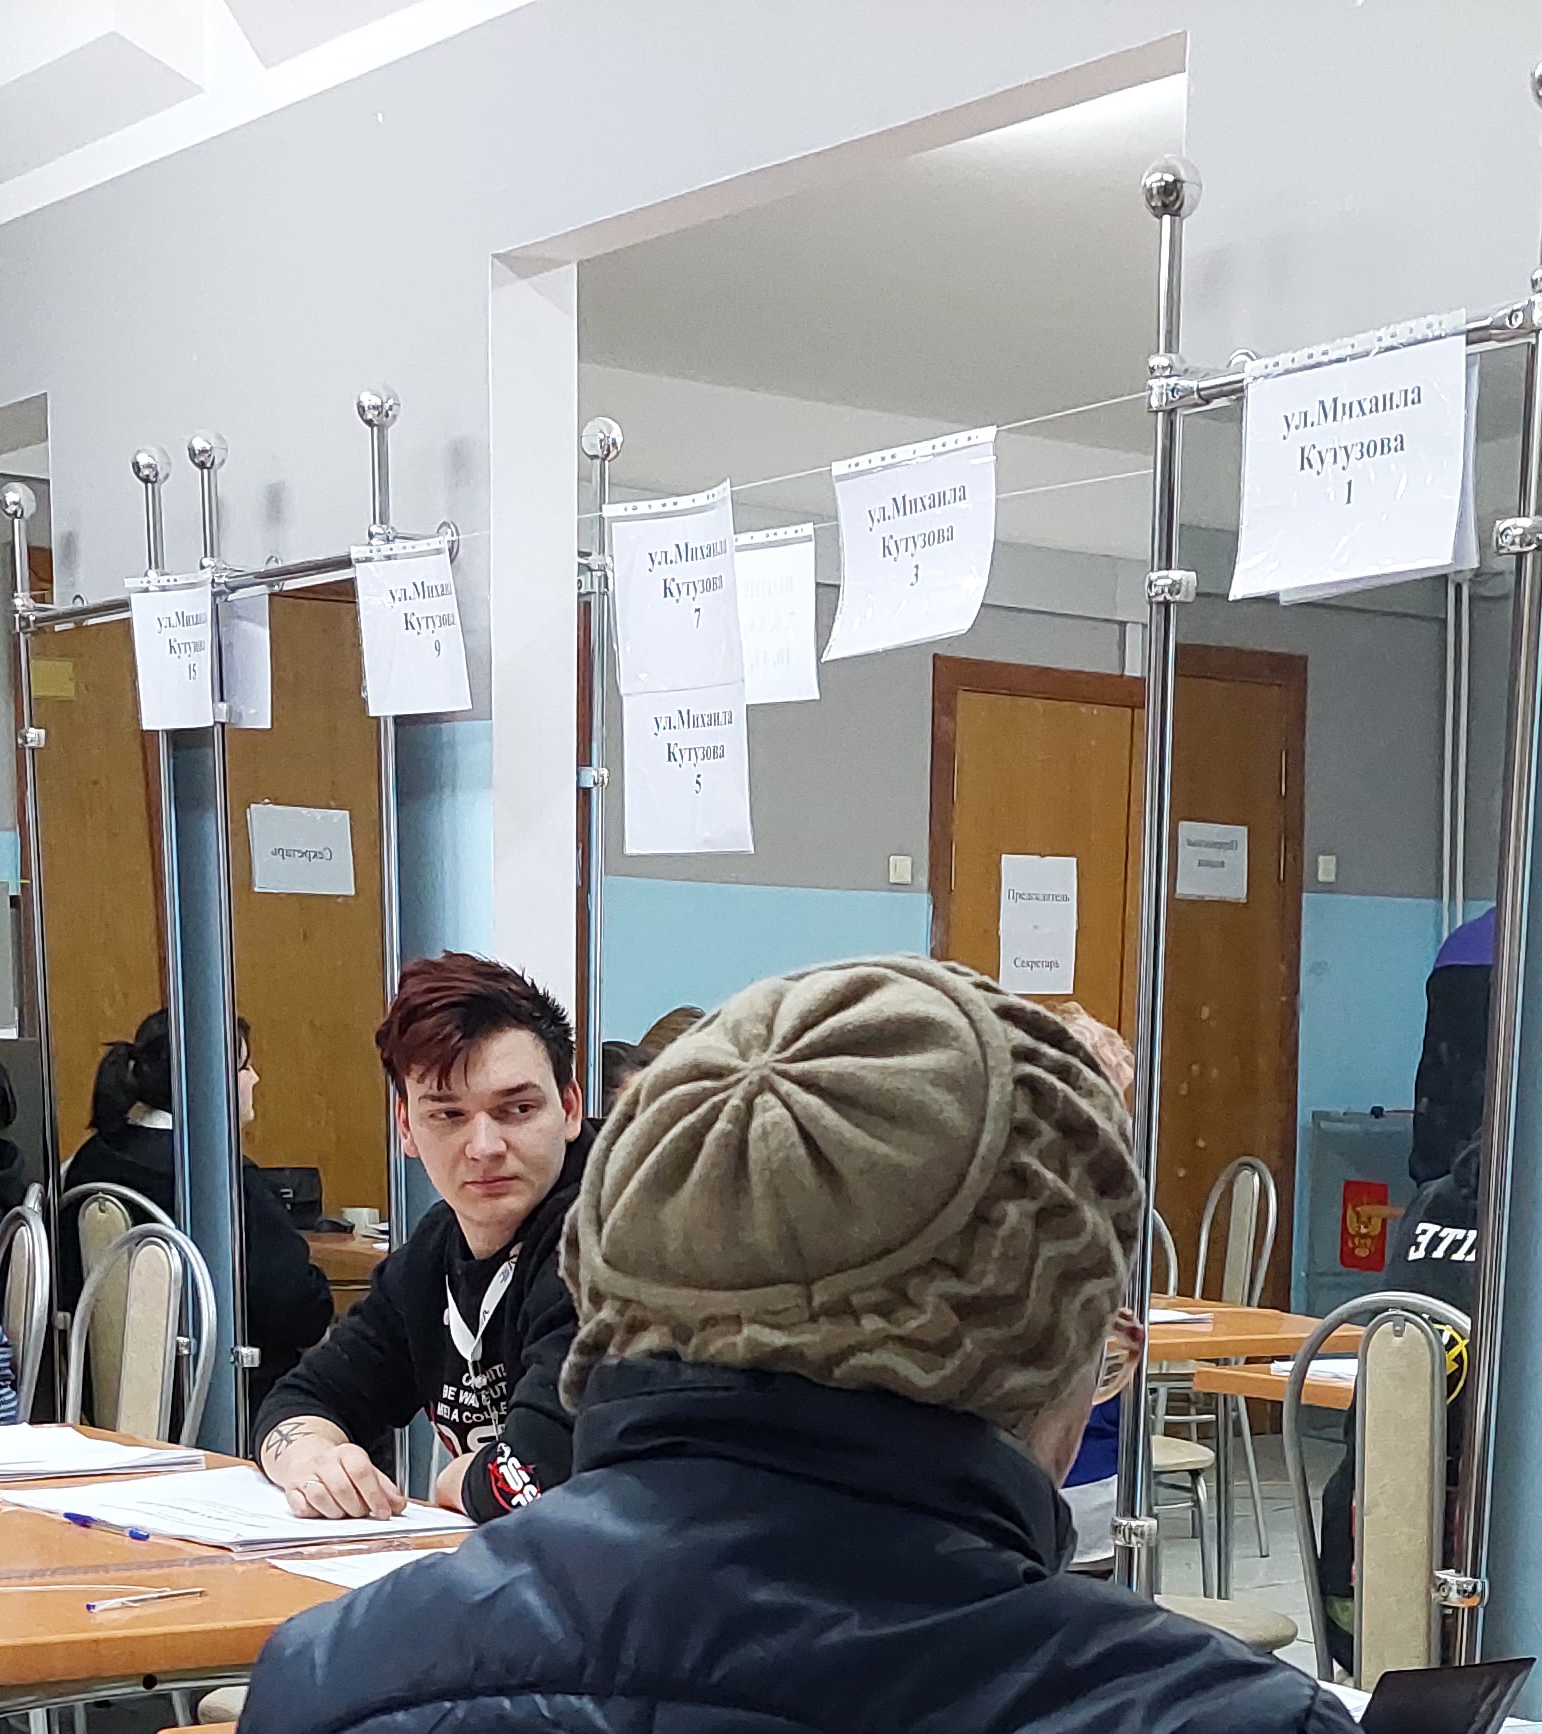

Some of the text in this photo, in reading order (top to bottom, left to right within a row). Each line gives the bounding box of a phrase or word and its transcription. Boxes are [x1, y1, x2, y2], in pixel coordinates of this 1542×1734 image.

[1282, 383, 1423, 441] ул.Михаила
[1298, 432, 1405, 476] Кутузова
[1343, 479, 1354, 506] 1
[867, 484, 967, 532] ул.Михаила
[881, 525, 954, 562] Кутузова
[909, 563, 920, 587] 3
[662, 574, 724, 604] Кутузова
[694, 607, 702, 629] 7
[434, 638, 442, 657] 9
[653, 708, 733, 736] ул.Михаила
[666, 742, 726, 769] Кутузова
[694, 772, 702, 794] 5
